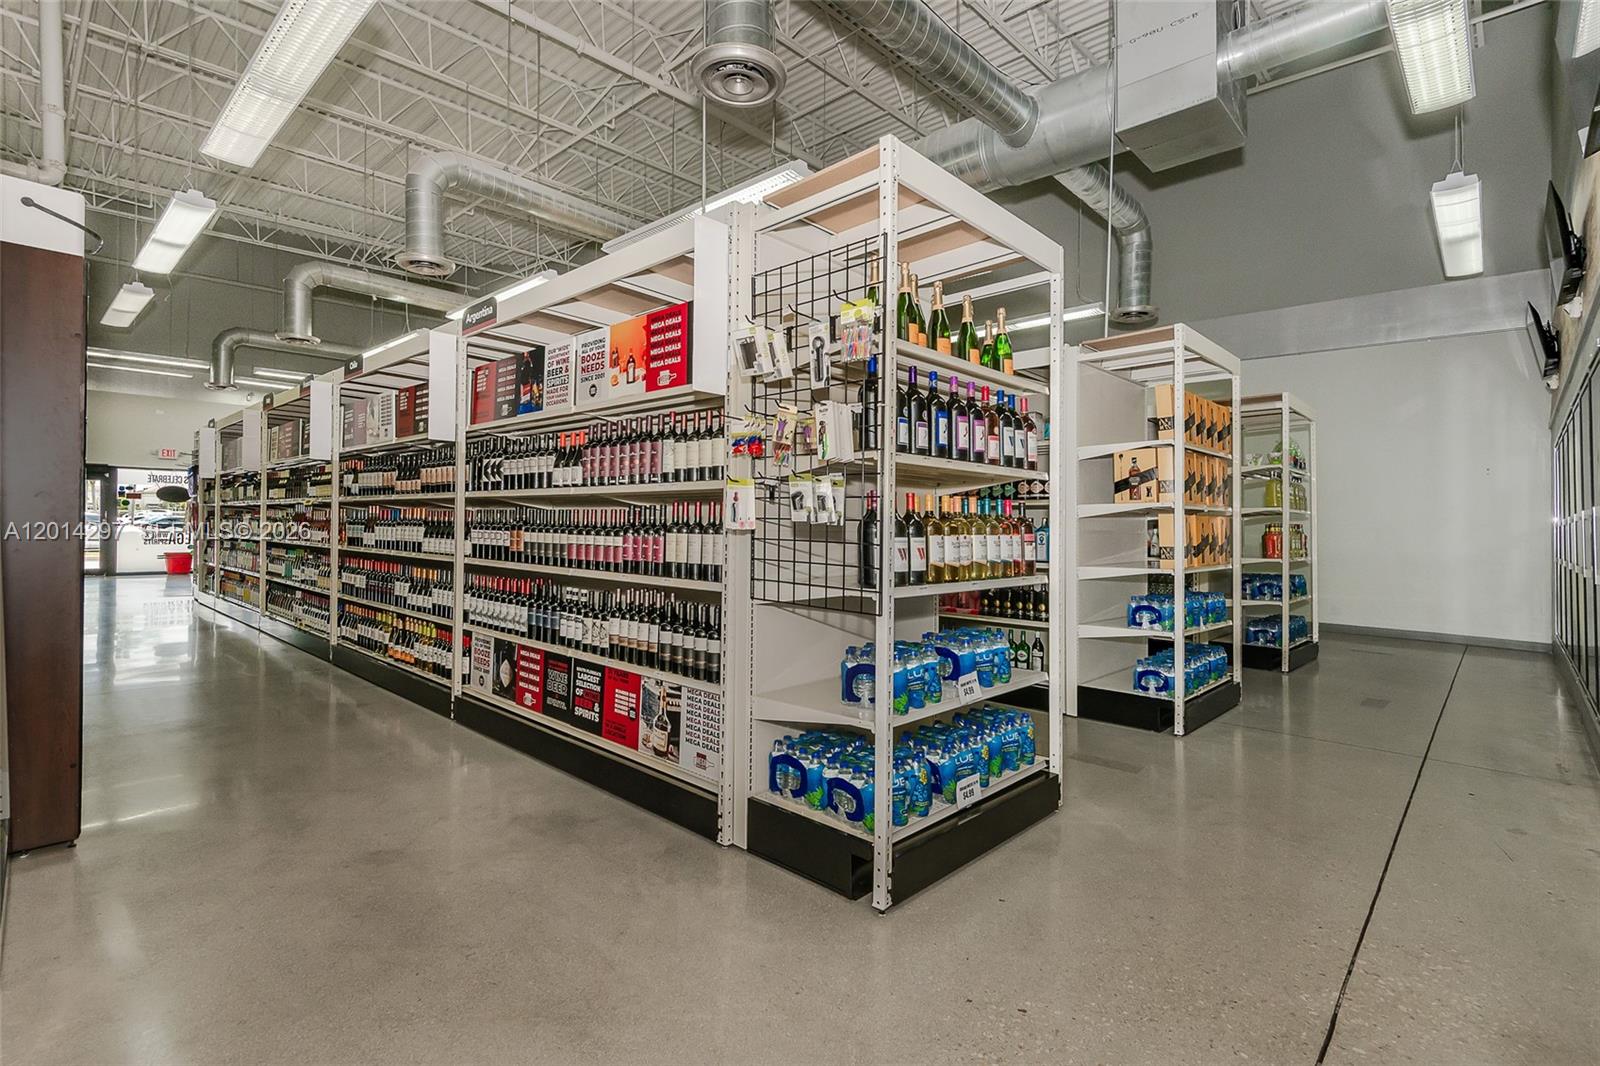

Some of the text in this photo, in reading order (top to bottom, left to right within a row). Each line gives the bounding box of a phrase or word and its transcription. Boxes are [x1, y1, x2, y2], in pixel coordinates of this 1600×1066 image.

[466, 305, 493, 324] Argentina
[650, 320, 664, 330] MEGA
[665, 316, 682, 326] DEALS
[582, 337, 606, 348] PROVIDING
[650, 334, 664, 342] MEGA
[665, 329, 682, 338] DEALS
[650, 347, 664, 356] MEGA
[664, 342, 681, 352] DEALS
[548, 356, 570, 368] OF WINE
[581, 350, 606, 364] BOOZE
[664, 356, 681, 365] DEALS
[546, 364, 570, 378] BEER &
[580, 360, 605, 374] NEEDS
[580, 375, 594, 384] SINCE
[161, 448, 176, 458] EXIT
[474, 648, 490, 658] BOOZE
[474, 656, 490, 667] NEEDS
[547, 668, 568, 684] WINE
[577, 672, 600, 684] LARGEST
[546, 680, 568, 696] BEER
[576, 680, 600, 692] SELECTION
[576, 688, 584, 696] OF
[687, 687, 720, 702] MEGA DEALS
[594, 702, 600, 712] &
[687, 695, 720, 710] MEGA DEALS
[687, 702, 720, 716] MEGA DEALS
[574, 706, 600, 722] SPIRITS
[686, 709, 720, 724] MEGA DEALS
[686, 716, 720, 731] MEGA DEALS
[686, 723, 720, 739] MEGA DEALS
[686, 730, 720, 746] MEGA DEALS
[685, 737, 719, 754] MEGA DEALS
